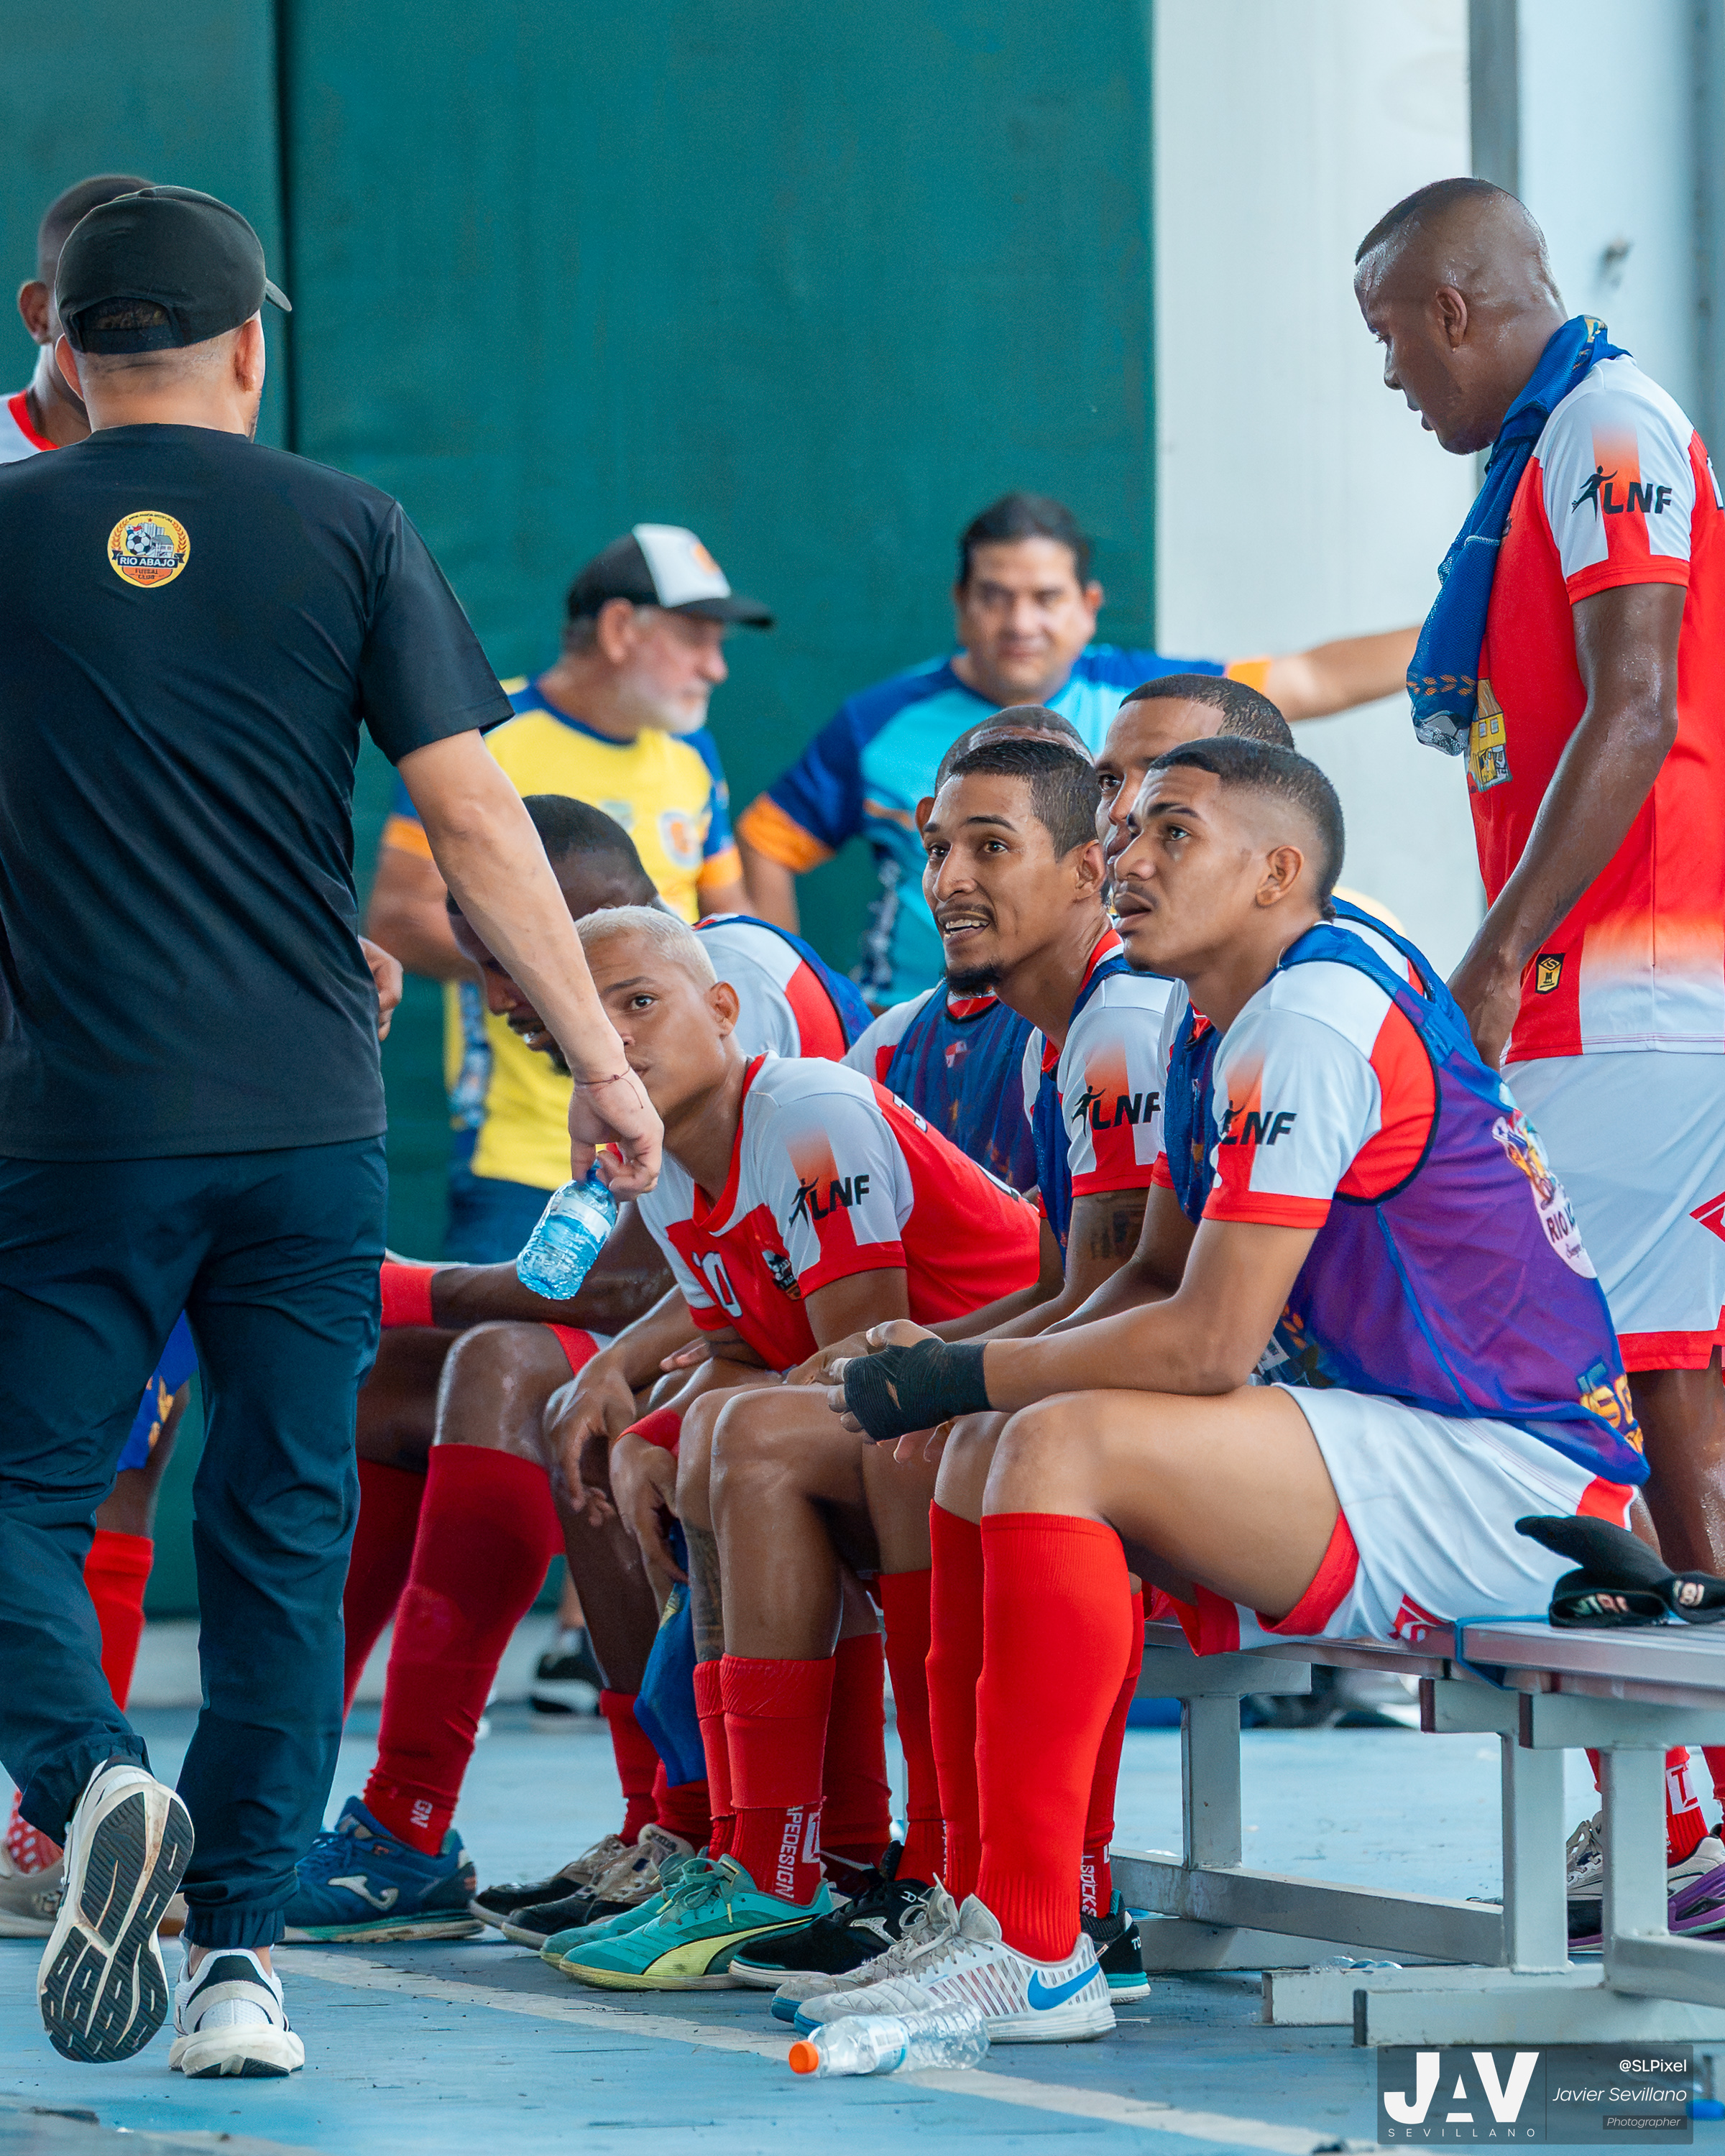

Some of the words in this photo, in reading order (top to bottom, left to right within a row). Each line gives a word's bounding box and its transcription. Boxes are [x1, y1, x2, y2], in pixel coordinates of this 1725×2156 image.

[1603, 481, 1673, 515] LNF
[119, 556, 138, 566] RIO
[139, 557, 175, 567] ABAJO
[1091, 1091, 1162, 1130] LNF
[809, 1174, 870, 1221] LNF
